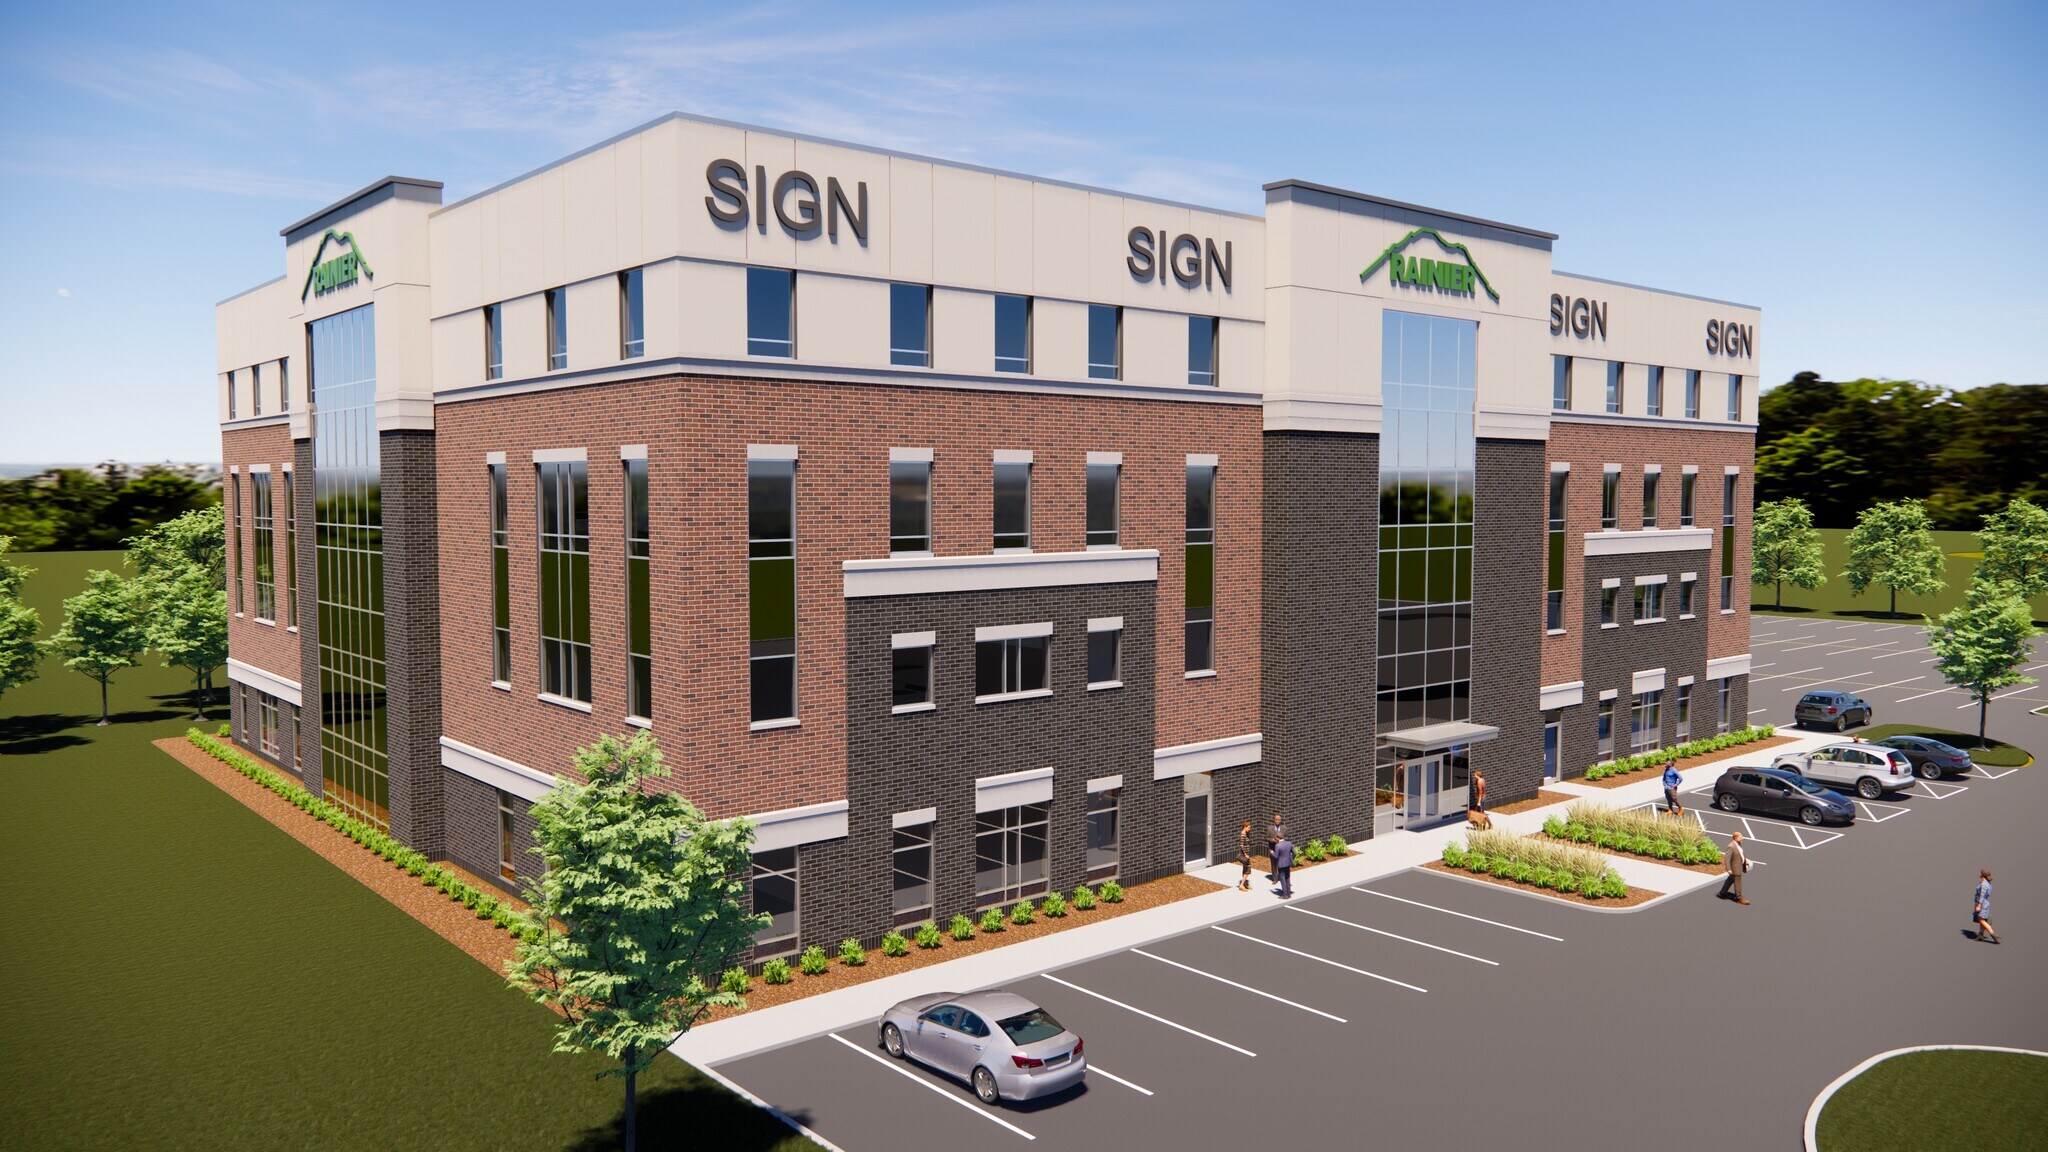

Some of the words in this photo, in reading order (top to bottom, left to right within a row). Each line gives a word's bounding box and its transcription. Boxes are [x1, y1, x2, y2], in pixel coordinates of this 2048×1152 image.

[705, 158, 867, 240] SIGN
[313, 252, 358, 292] RAINIER
[1126, 226, 1232, 288] SIGN
[1390, 253, 1476, 293] RAINIER
[1550, 293, 1607, 338] SIGN
[1706, 318, 1752, 359] SIGN
